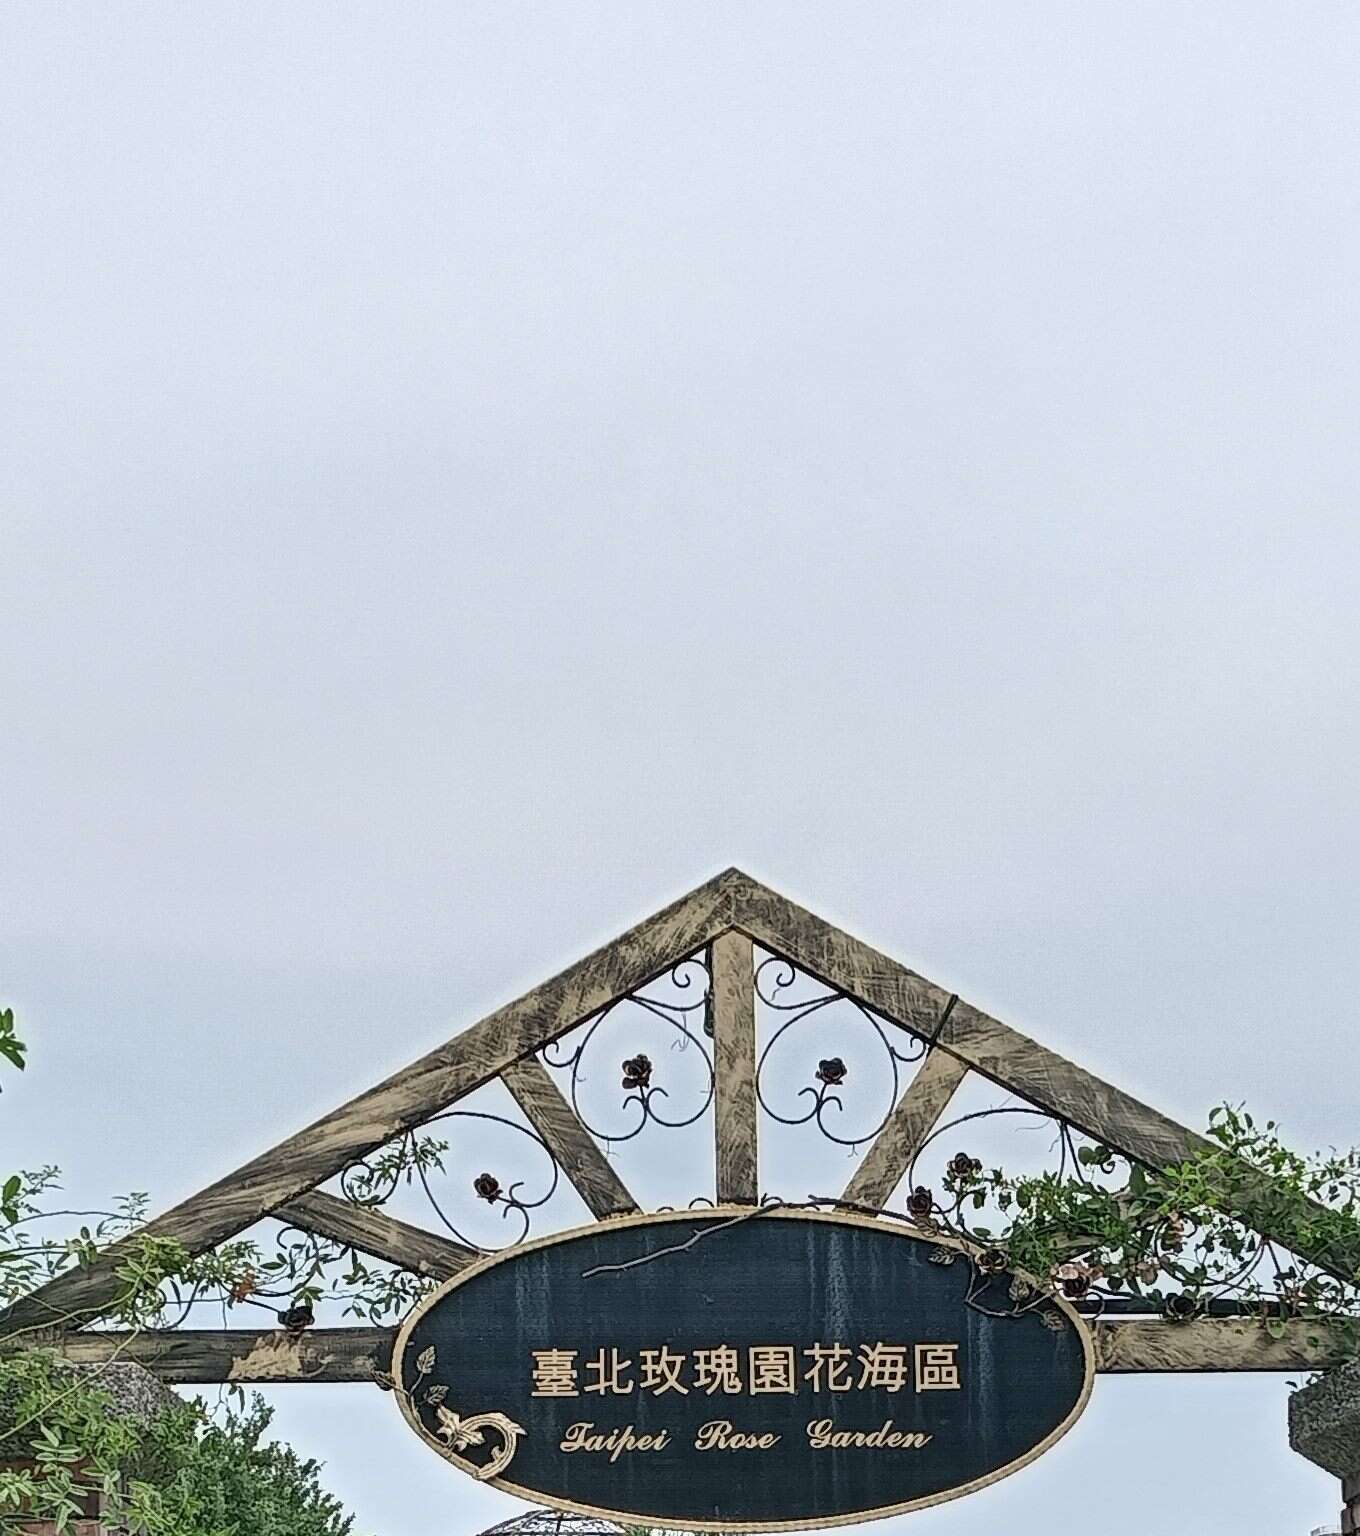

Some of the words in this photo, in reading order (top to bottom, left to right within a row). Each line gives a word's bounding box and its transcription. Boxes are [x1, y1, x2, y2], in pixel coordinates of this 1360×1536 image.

[531, 1341, 961, 1397] 臺北玫瑰園花海區
[559, 1422, 671, 1462] Taipei
[694, 1420, 781, 1450] Rose
[806, 1418, 933, 1449] Garden
